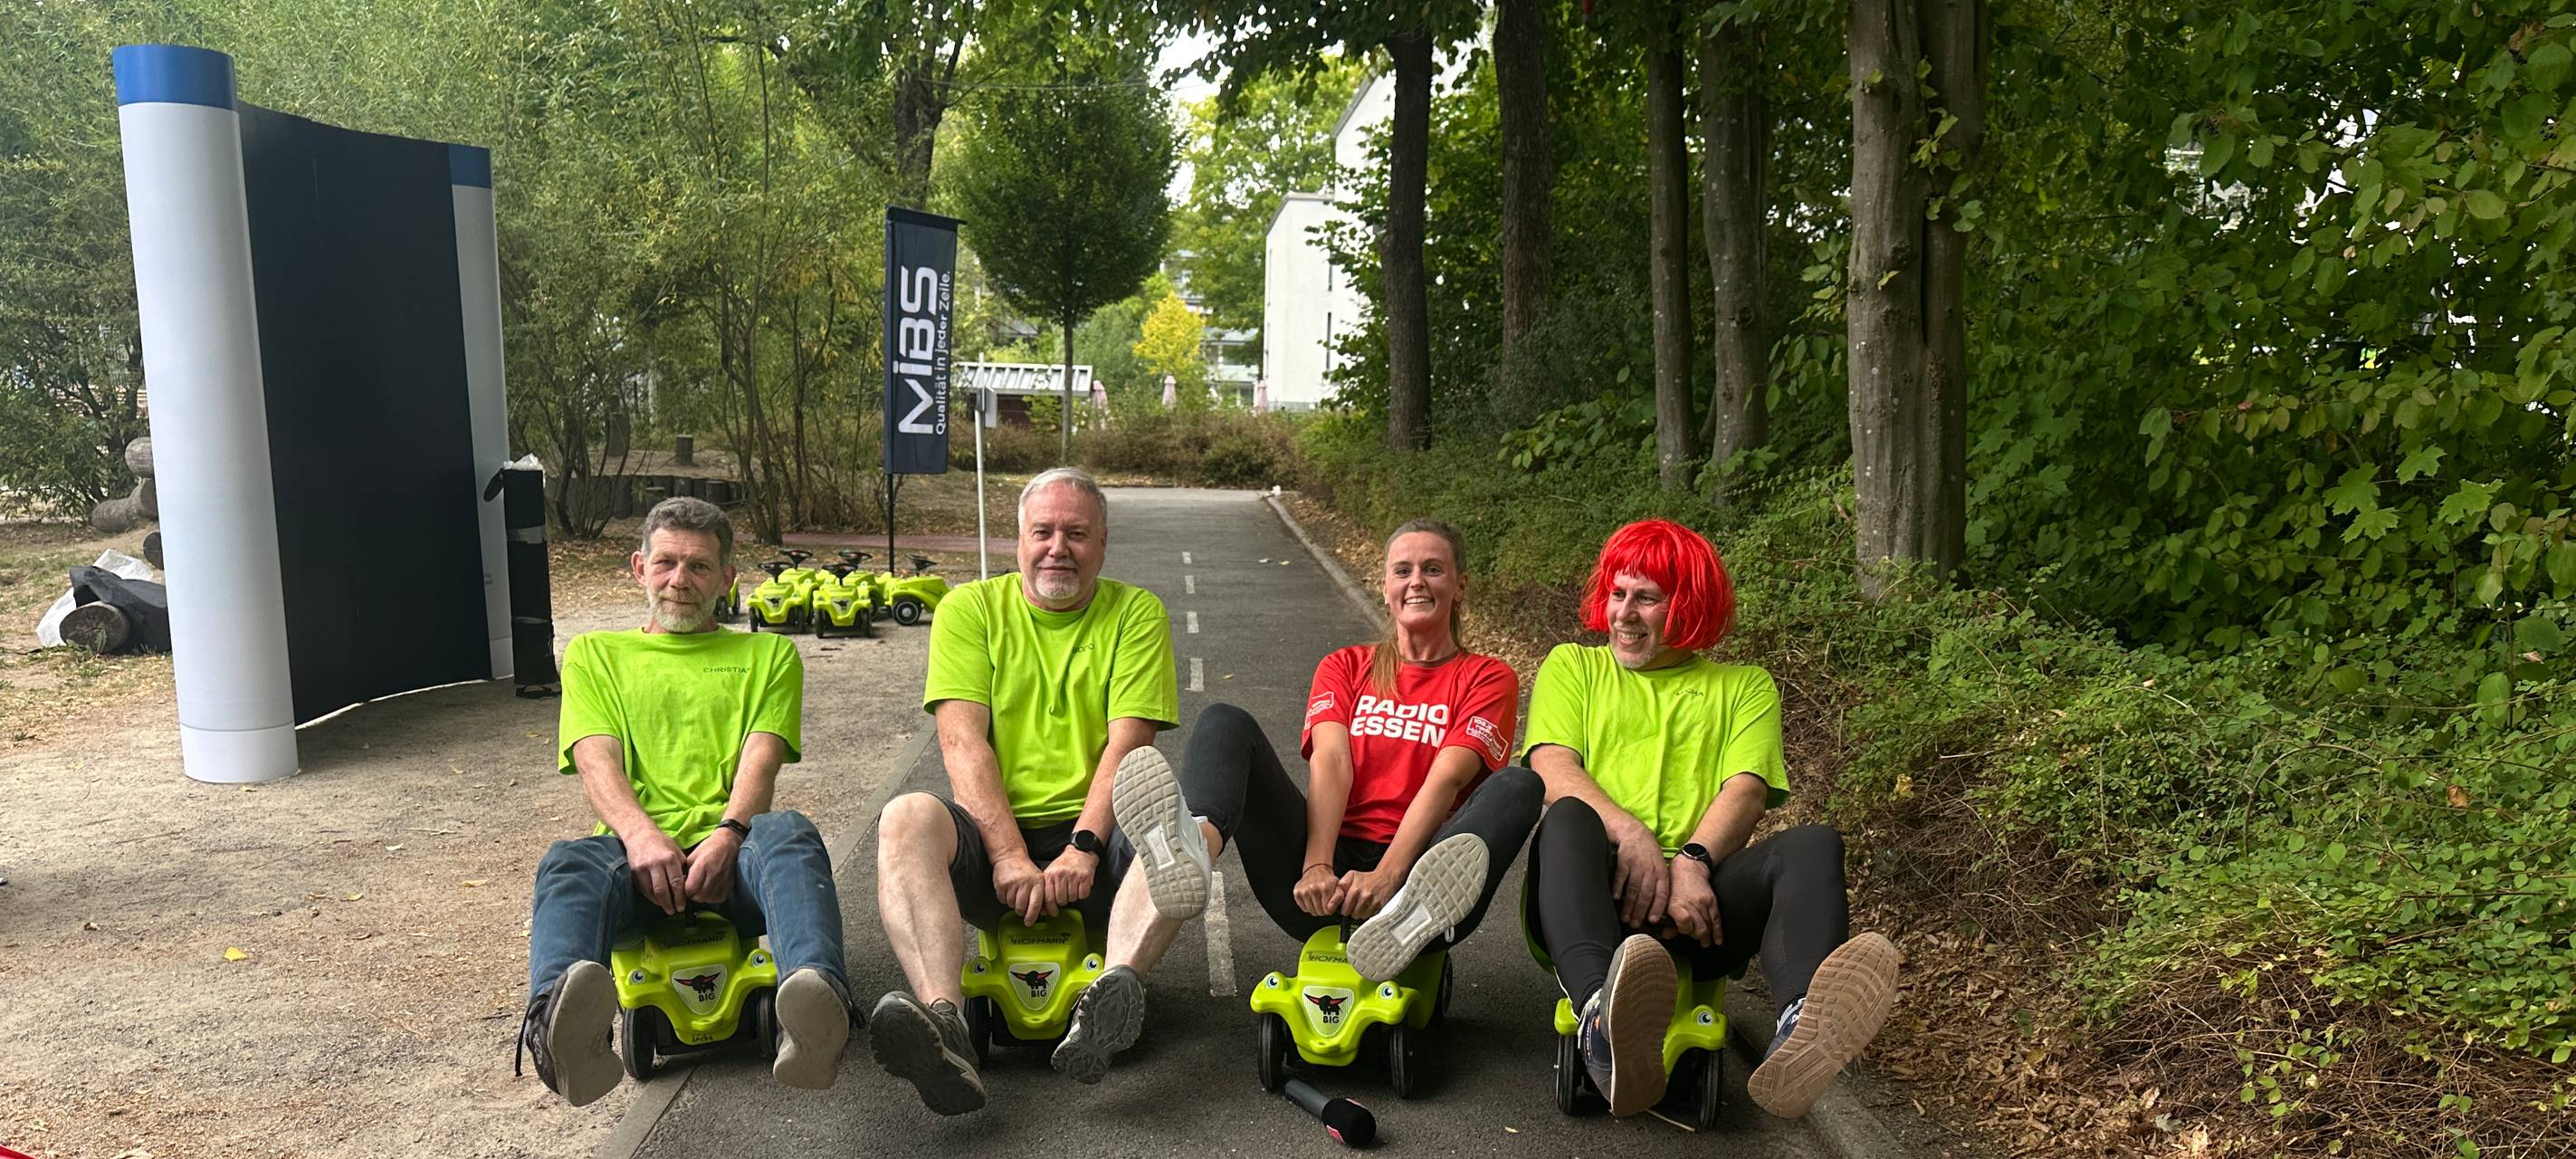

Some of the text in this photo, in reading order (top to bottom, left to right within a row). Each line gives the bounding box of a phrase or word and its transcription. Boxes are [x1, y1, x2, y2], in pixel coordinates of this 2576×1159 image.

[934, 271, 950, 435] Qualität in jeder Zeile.
[1355, 695, 1449, 725] RADIO
[1350, 716, 1445, 747] ESSEN
[1309, 953, 1350, 963] HOFMA
[698, 992, 716, 1002] BIG
[1030, 990, 1047, 998] BIG
[1322, 1015, 1340, 1024] BIG
